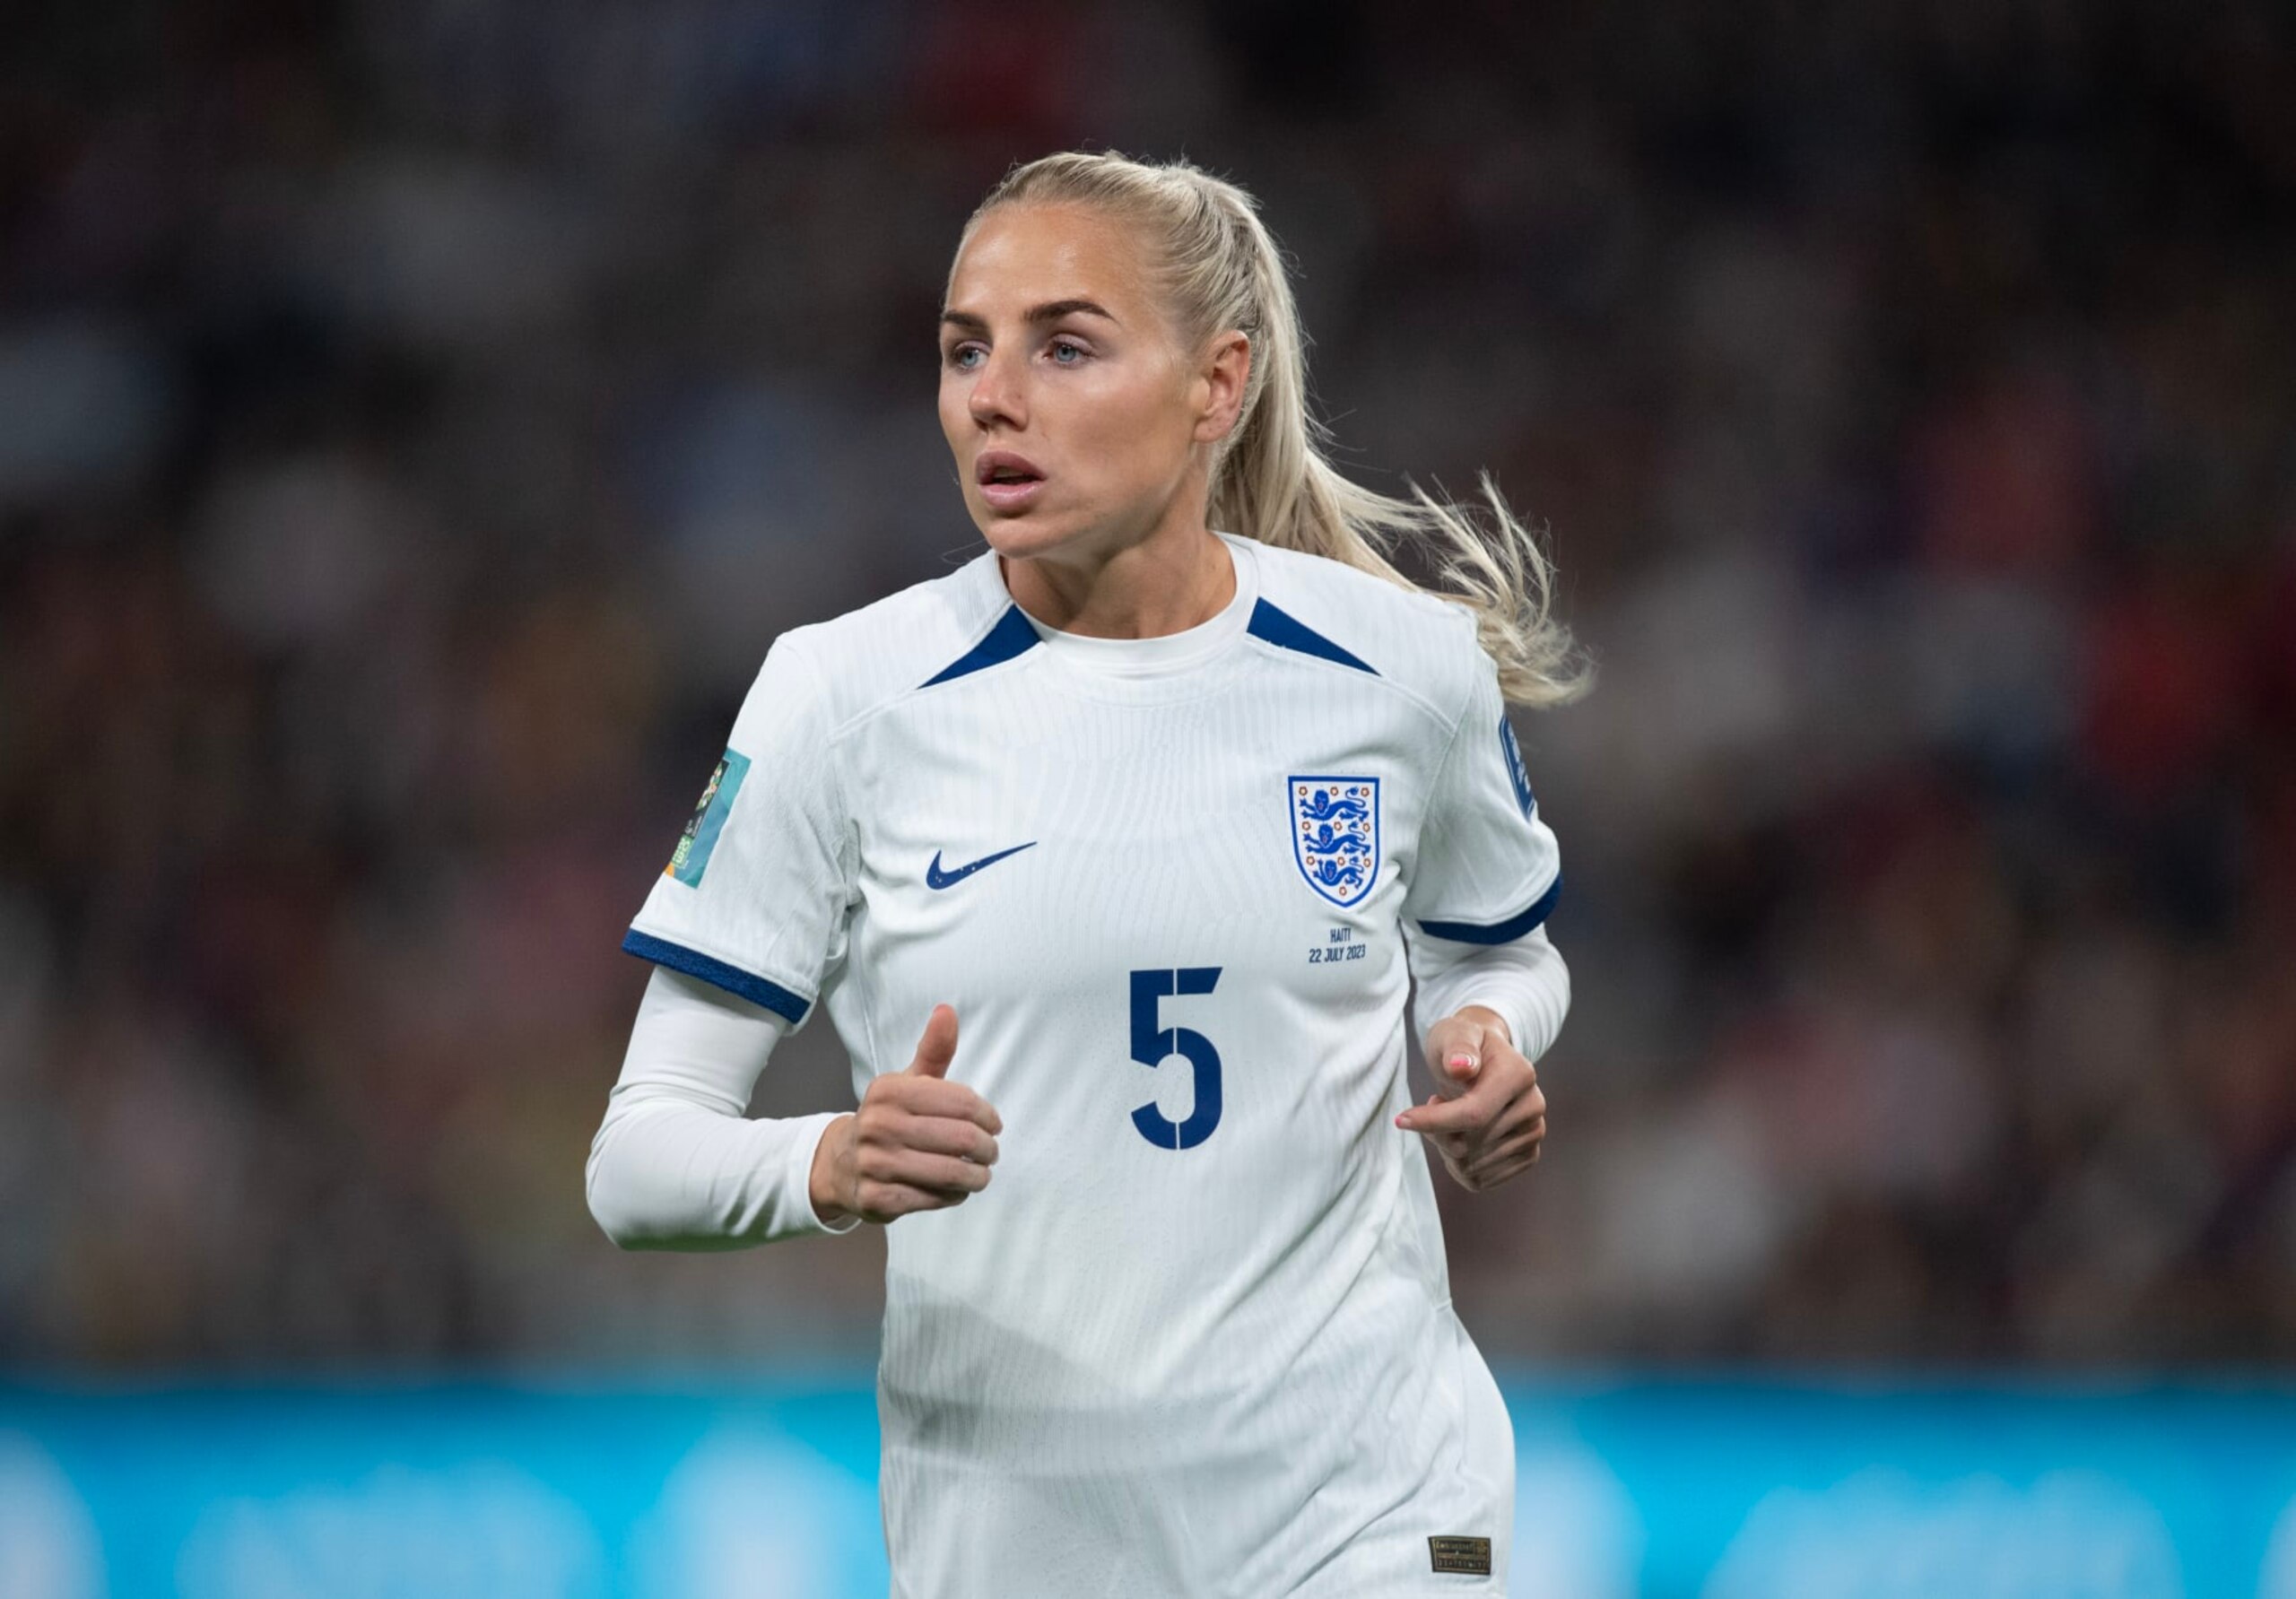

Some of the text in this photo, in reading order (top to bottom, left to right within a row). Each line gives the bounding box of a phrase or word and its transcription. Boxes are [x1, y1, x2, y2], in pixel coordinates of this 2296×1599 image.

[1330, 927, 1352, 943] HAITI
[1309, 943, 1366, 963] 22 JULY 2023
[1130, 967, 1222, 1150] 5
